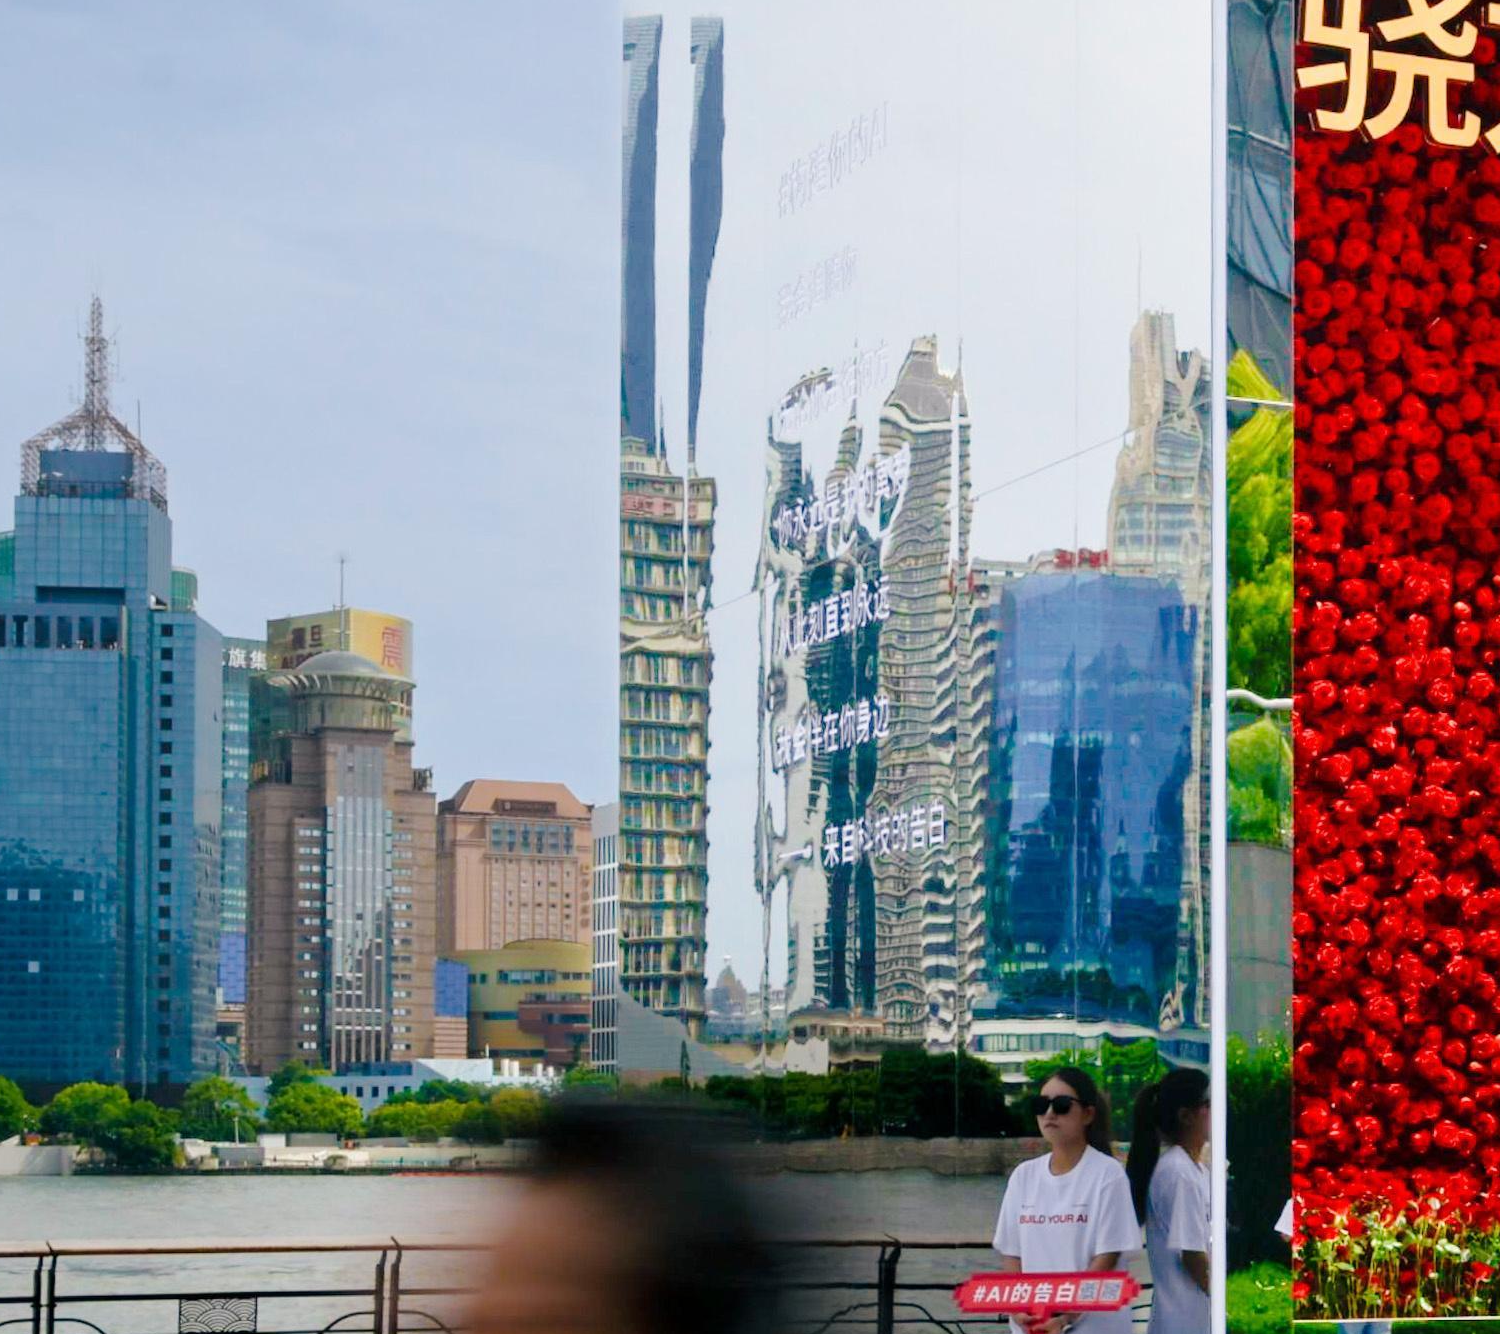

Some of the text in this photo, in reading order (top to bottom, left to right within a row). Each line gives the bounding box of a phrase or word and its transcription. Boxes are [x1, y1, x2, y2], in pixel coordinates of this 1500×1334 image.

[222, 646, 267, 670] 旗集
[1019, 1214, 1088, 1225] BUILD YOUR AI
[972, 1281, 1076, 1304] #AI的告白
